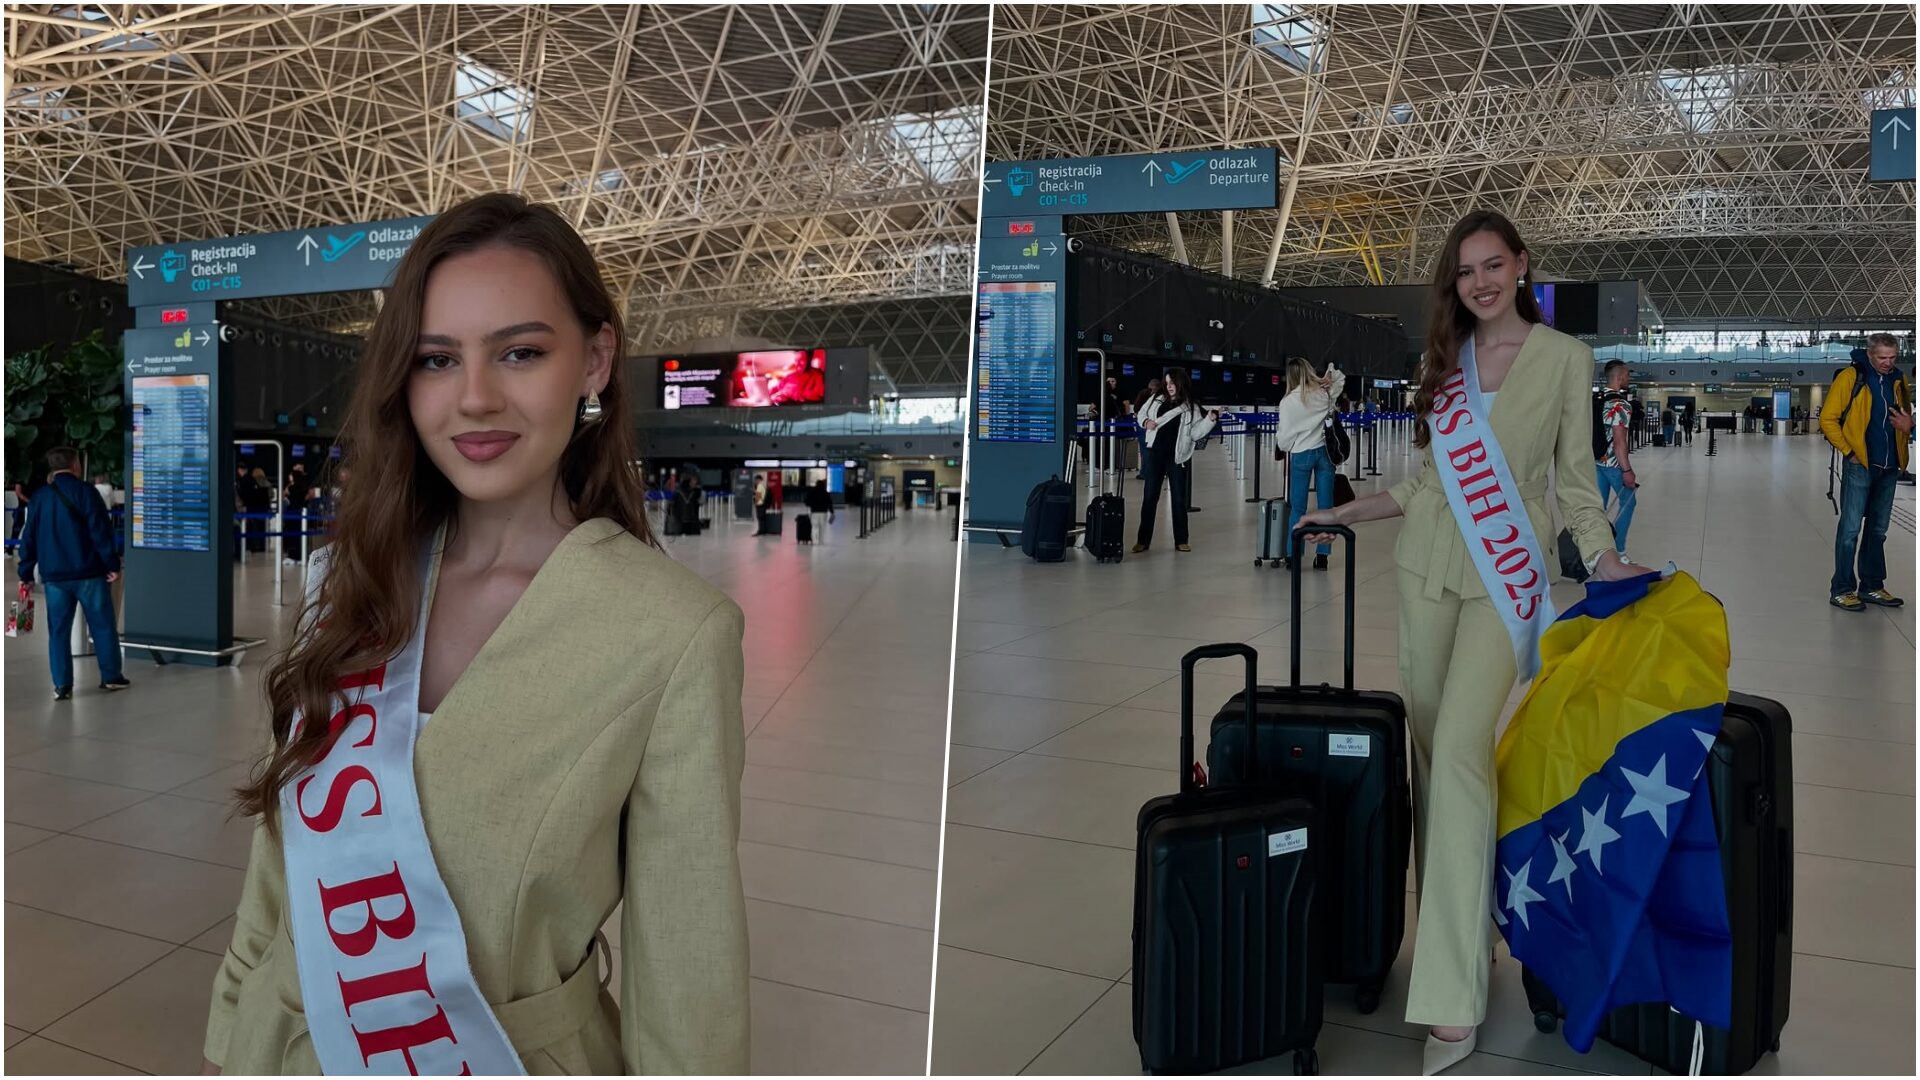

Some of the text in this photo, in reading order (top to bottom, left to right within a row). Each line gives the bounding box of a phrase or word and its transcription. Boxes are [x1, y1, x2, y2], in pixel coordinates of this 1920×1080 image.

[1209, 155, 1257, 170] Odlazak
[1039, 164, 1102, 180] Registracija
[1209, 172, 1269, 187] Departure
[1039, 180, 1084, 192] Check-In
[1039, 195, 1058, 206] C01
[1070, 193, 1088, 206] C15
[368, 224, 421, 244] Odlazak
[191, 242, 256, 263] Registracija
[368, 245, 411, 262] Depar
[191, 261, 238, 277] Check-In
[191, 279, 211, 292] C01
[222, 276, 242, 290] C15
[1432, 367, 1543, 621] ISS BIH 2025
[296, 655, 389, 833] ISS
